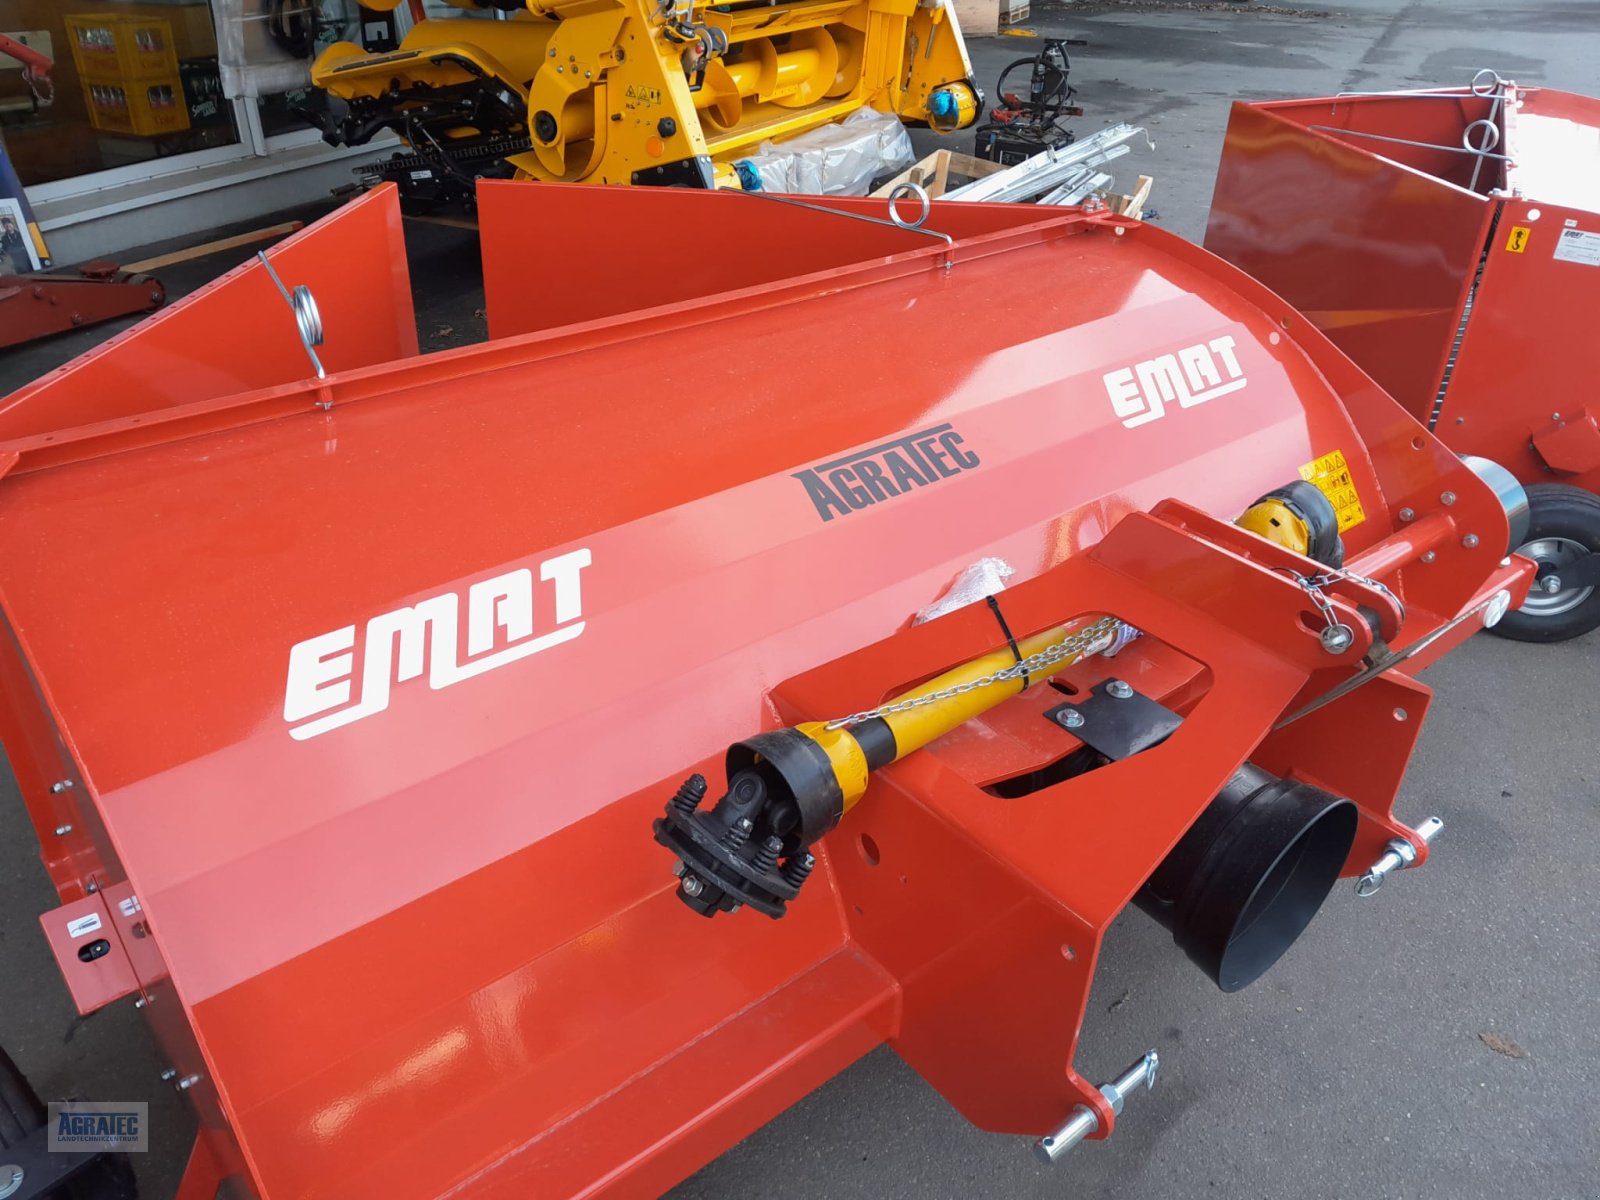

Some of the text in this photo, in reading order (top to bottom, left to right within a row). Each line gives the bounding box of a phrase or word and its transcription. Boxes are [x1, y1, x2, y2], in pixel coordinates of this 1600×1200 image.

[1103, 335, 1247, 429] EMAT
[790, 422, 980, 523] AGRATEC
[283, 548, 592, 741] EMAT
